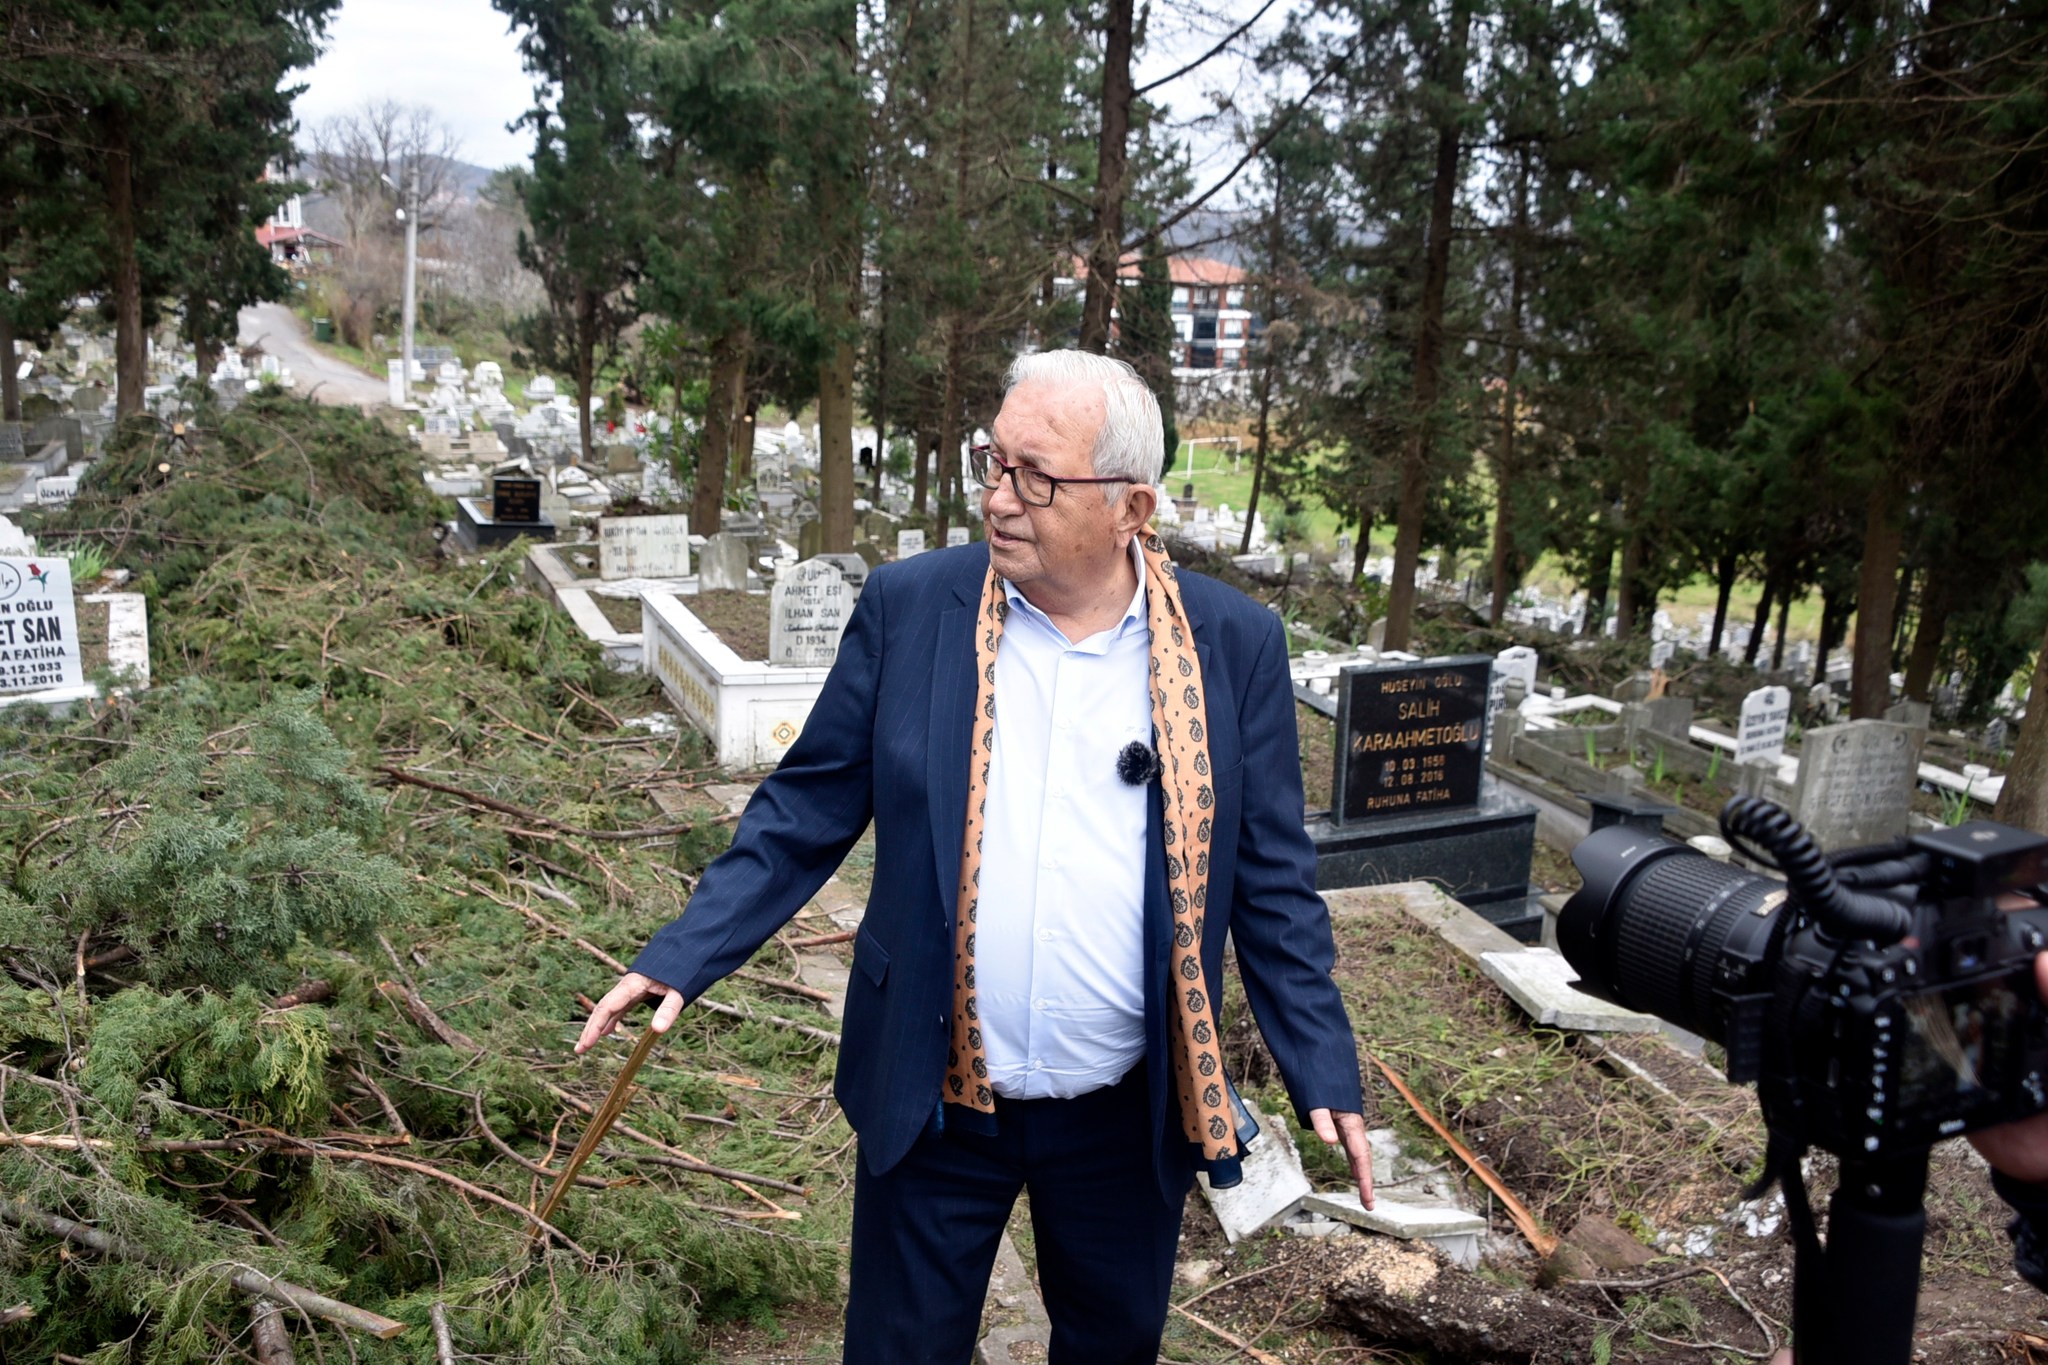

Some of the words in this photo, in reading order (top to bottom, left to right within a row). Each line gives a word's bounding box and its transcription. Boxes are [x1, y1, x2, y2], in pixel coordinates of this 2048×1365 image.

[16, 599, 53, 614] OĞLU
[23, 616, 62, 643] SAN
[14, 645, 66, 660] FATİHA
[1398, 699, 1441, 720] SALİH
[1352, 722, 1480, 752] KARAAHMETOĞLU
[1367, 793, 1411, 809] RUHUNA
[1416, 788, 1451, 803] FATİHA
